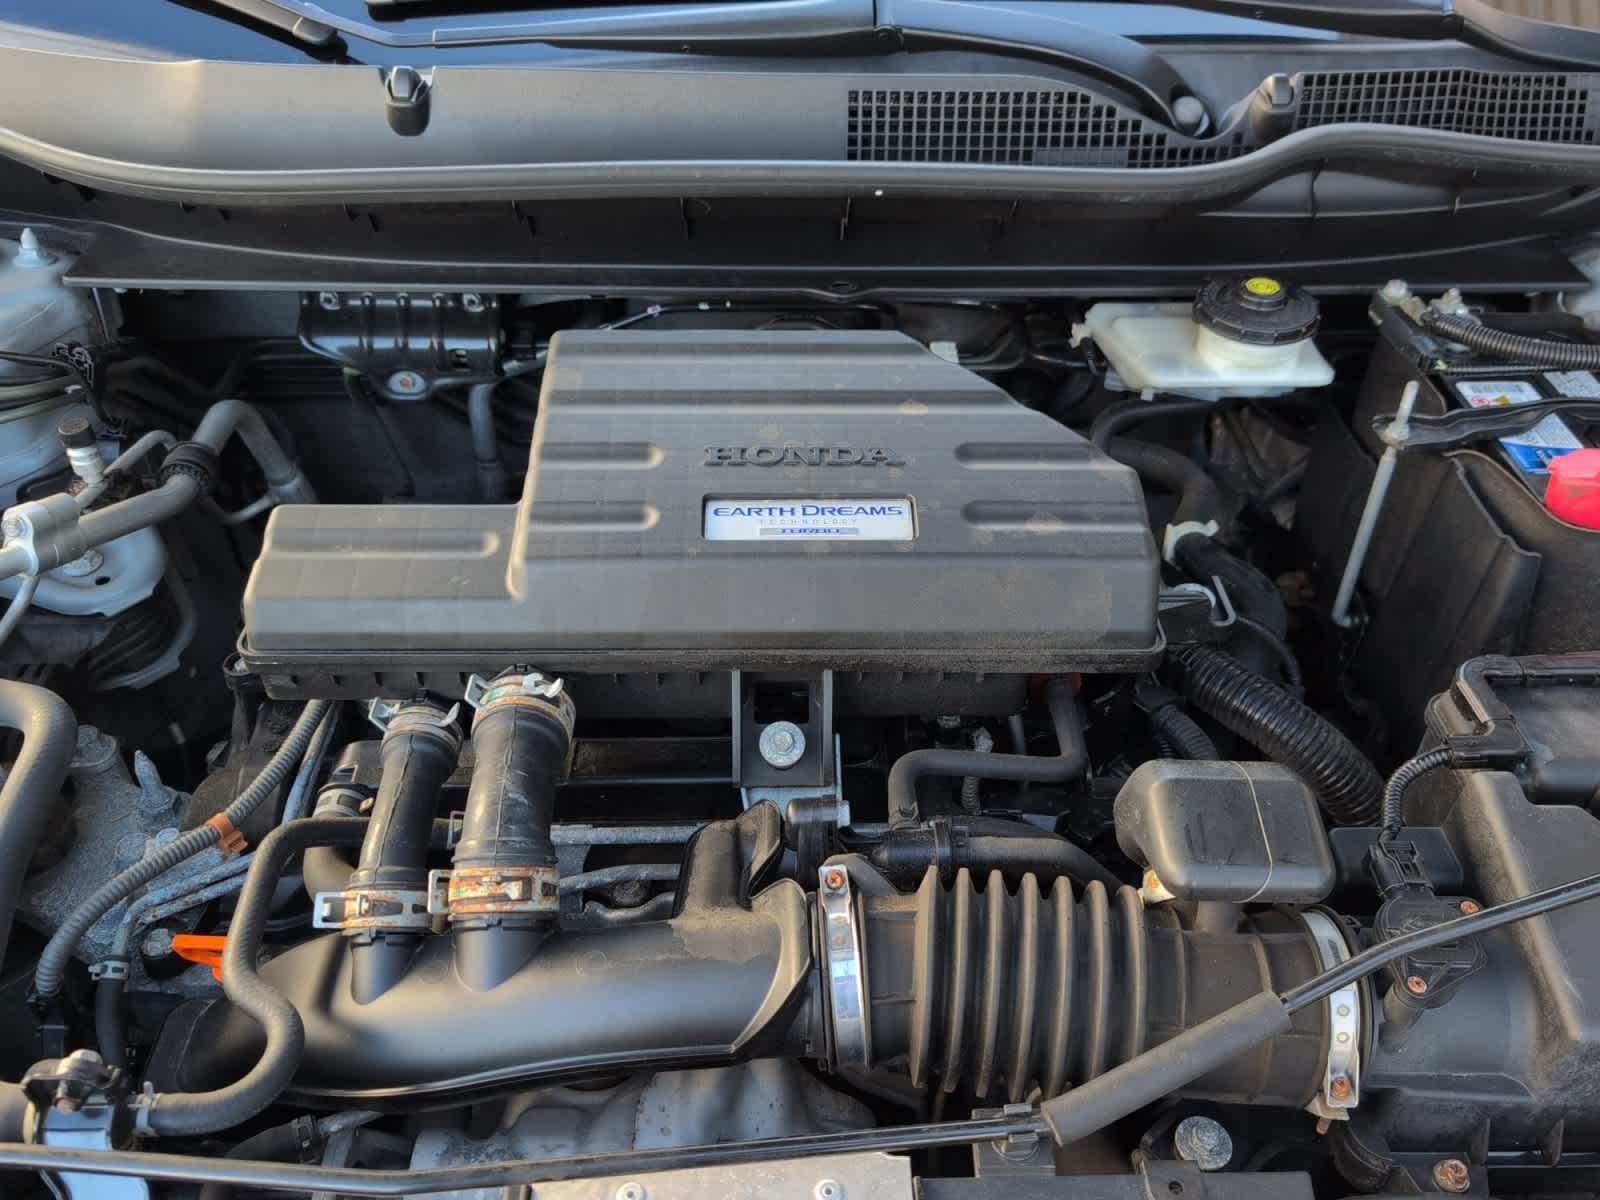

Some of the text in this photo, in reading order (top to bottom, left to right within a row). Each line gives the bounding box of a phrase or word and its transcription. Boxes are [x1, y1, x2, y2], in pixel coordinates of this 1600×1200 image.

[703, 446, 906, 467] HONDA
[713, 505, 903, 517] EARTH DREAMS
[759, 518, 858, 526] TECHNOLOGY
